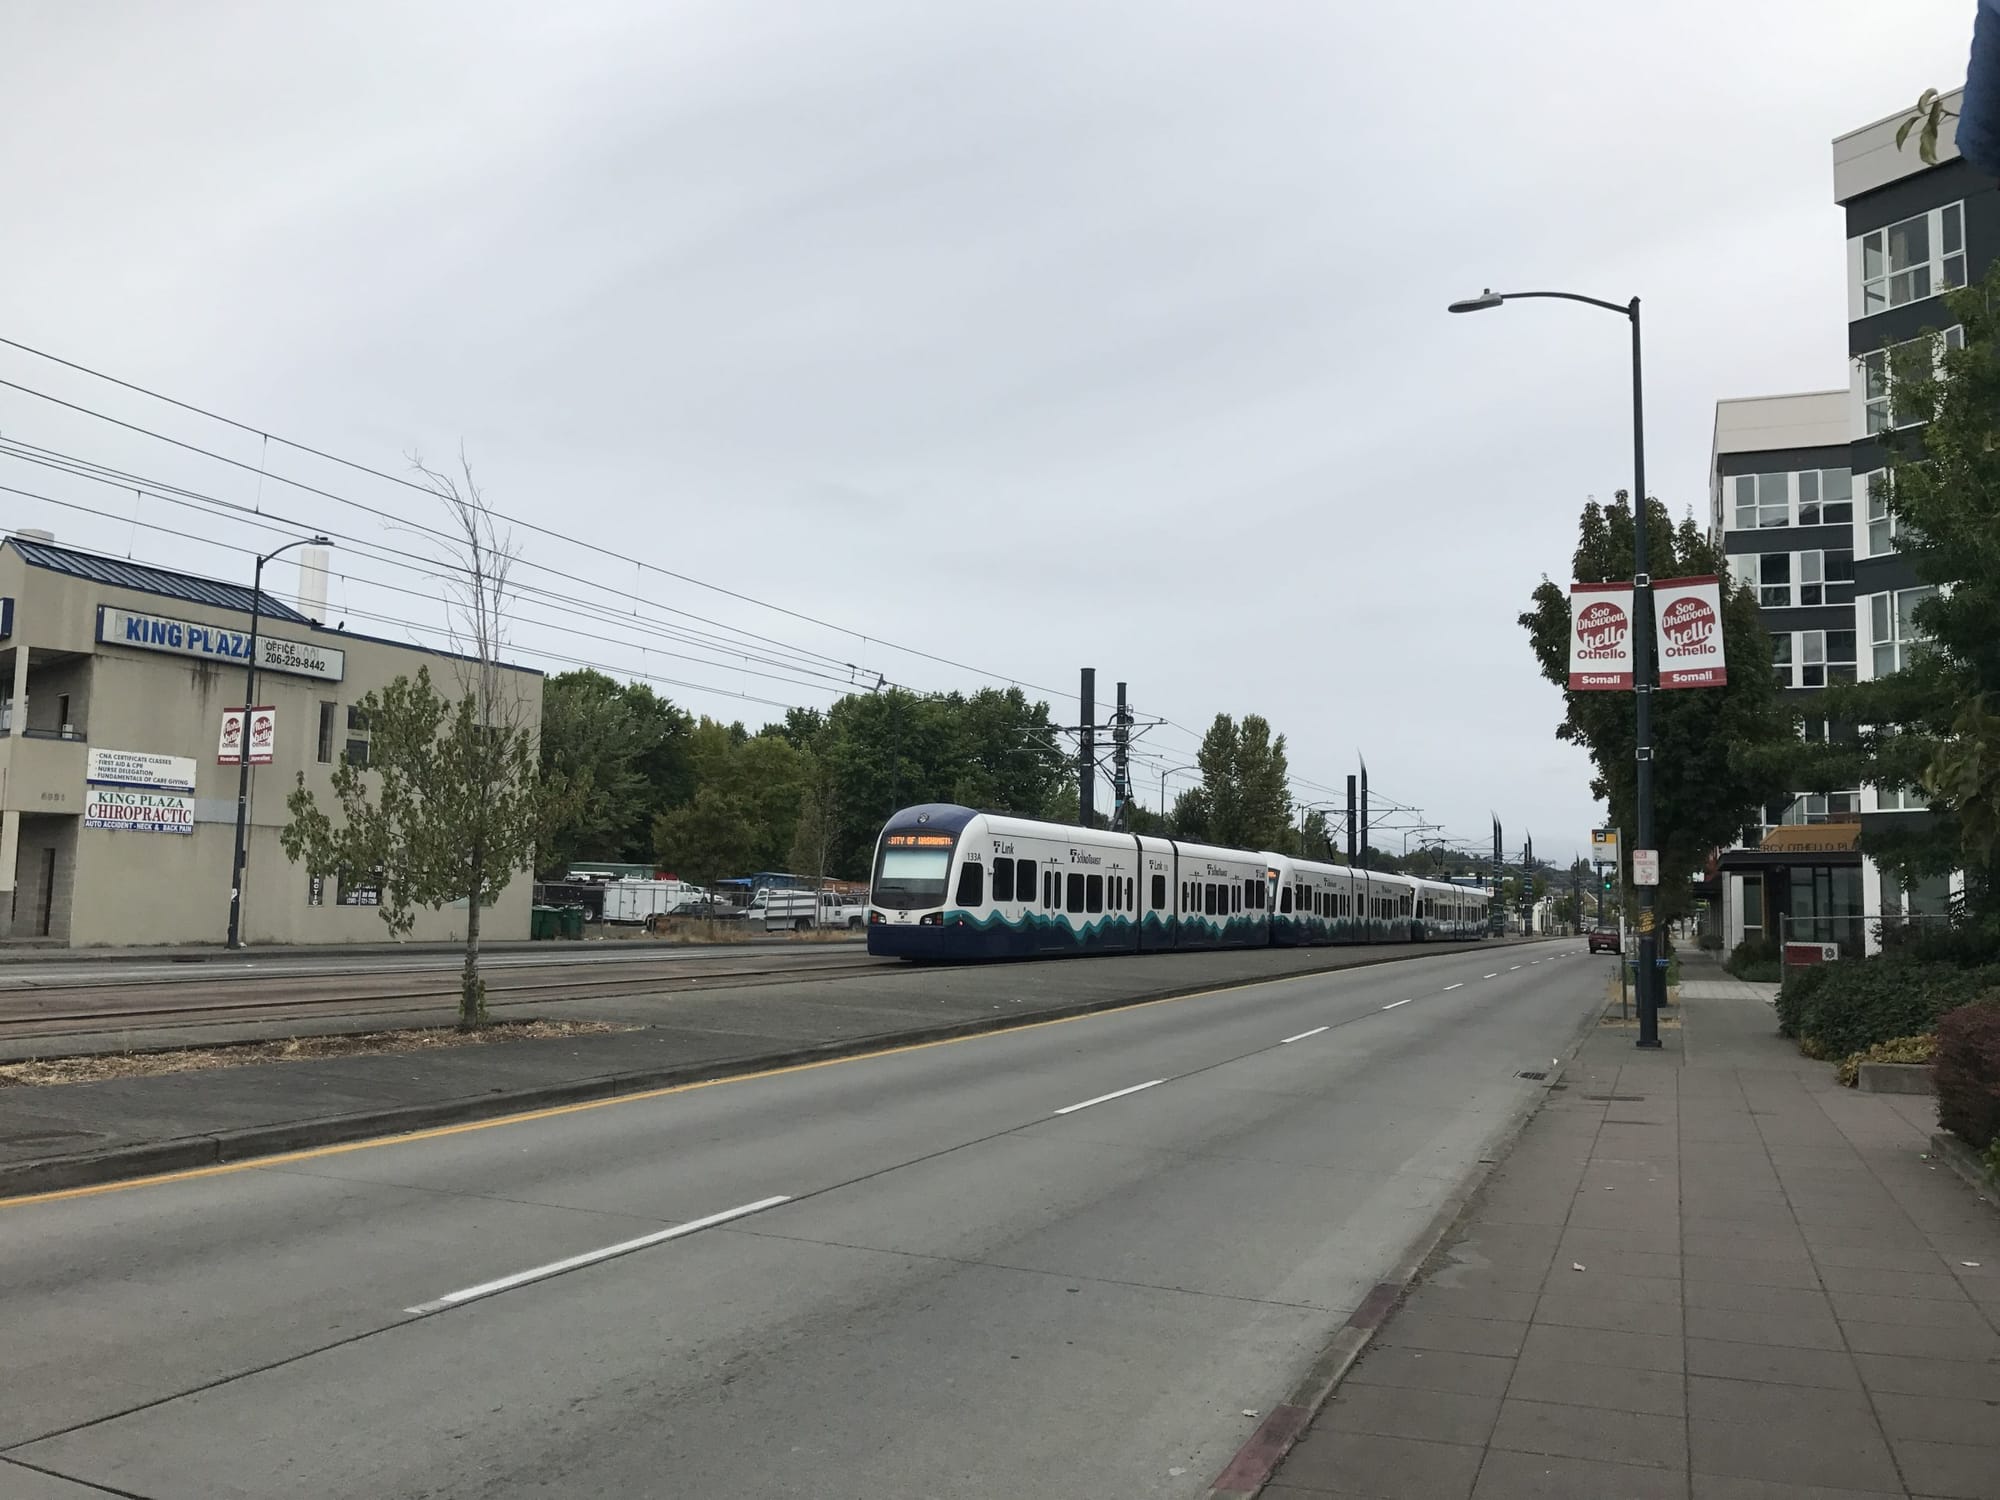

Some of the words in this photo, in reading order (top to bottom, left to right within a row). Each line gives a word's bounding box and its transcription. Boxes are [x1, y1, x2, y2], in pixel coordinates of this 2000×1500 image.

[1590, 607, 1610, 620] Soo
[1675, 602, 1695, 615] Soo
[126, 617, 182, 648] KING
[188, 628, 255, 660] PLAZA
[1583, 625, 1626, 648] hello
[1670, 621, 1714, 646] hello
[266, 641, 295, 655] OFFICE
[1577, 649, 1627, 660] Othello
[1665, 644, 1717, 658] Othello
[265, 652, 325, 671] 206-229-8442
[1581, 675, 1621, 685] Somali
[1672, 671, 1713, 683] Somali
[113, 753, 147, 762] CERTIFICATE
[148, 757, 172, 765] CLASSES
[118, 767, 153, 776] DELEGATION
[97, 773, 143, 782] FUNDAMENTALS
[168, 778, 189, 786] GIVING
[98, 792, 136, 805] KING
[140, 795, 184, 808] PLAZA
[88, 802, 192, 824] CHIROPRACTIC
[86, 820, 102, 828] AUTO
[102, 821, 133, 829] ACCIDENT
[163, 824, 178, 832] BACK
[179, 825, 192, 833] PAIN
[888, 836, 905, 845] SITY
[906, 836, 917, 845] OF
[1001, 841, 1014, 855] Link
[967, 852, 982, 862] 133A
